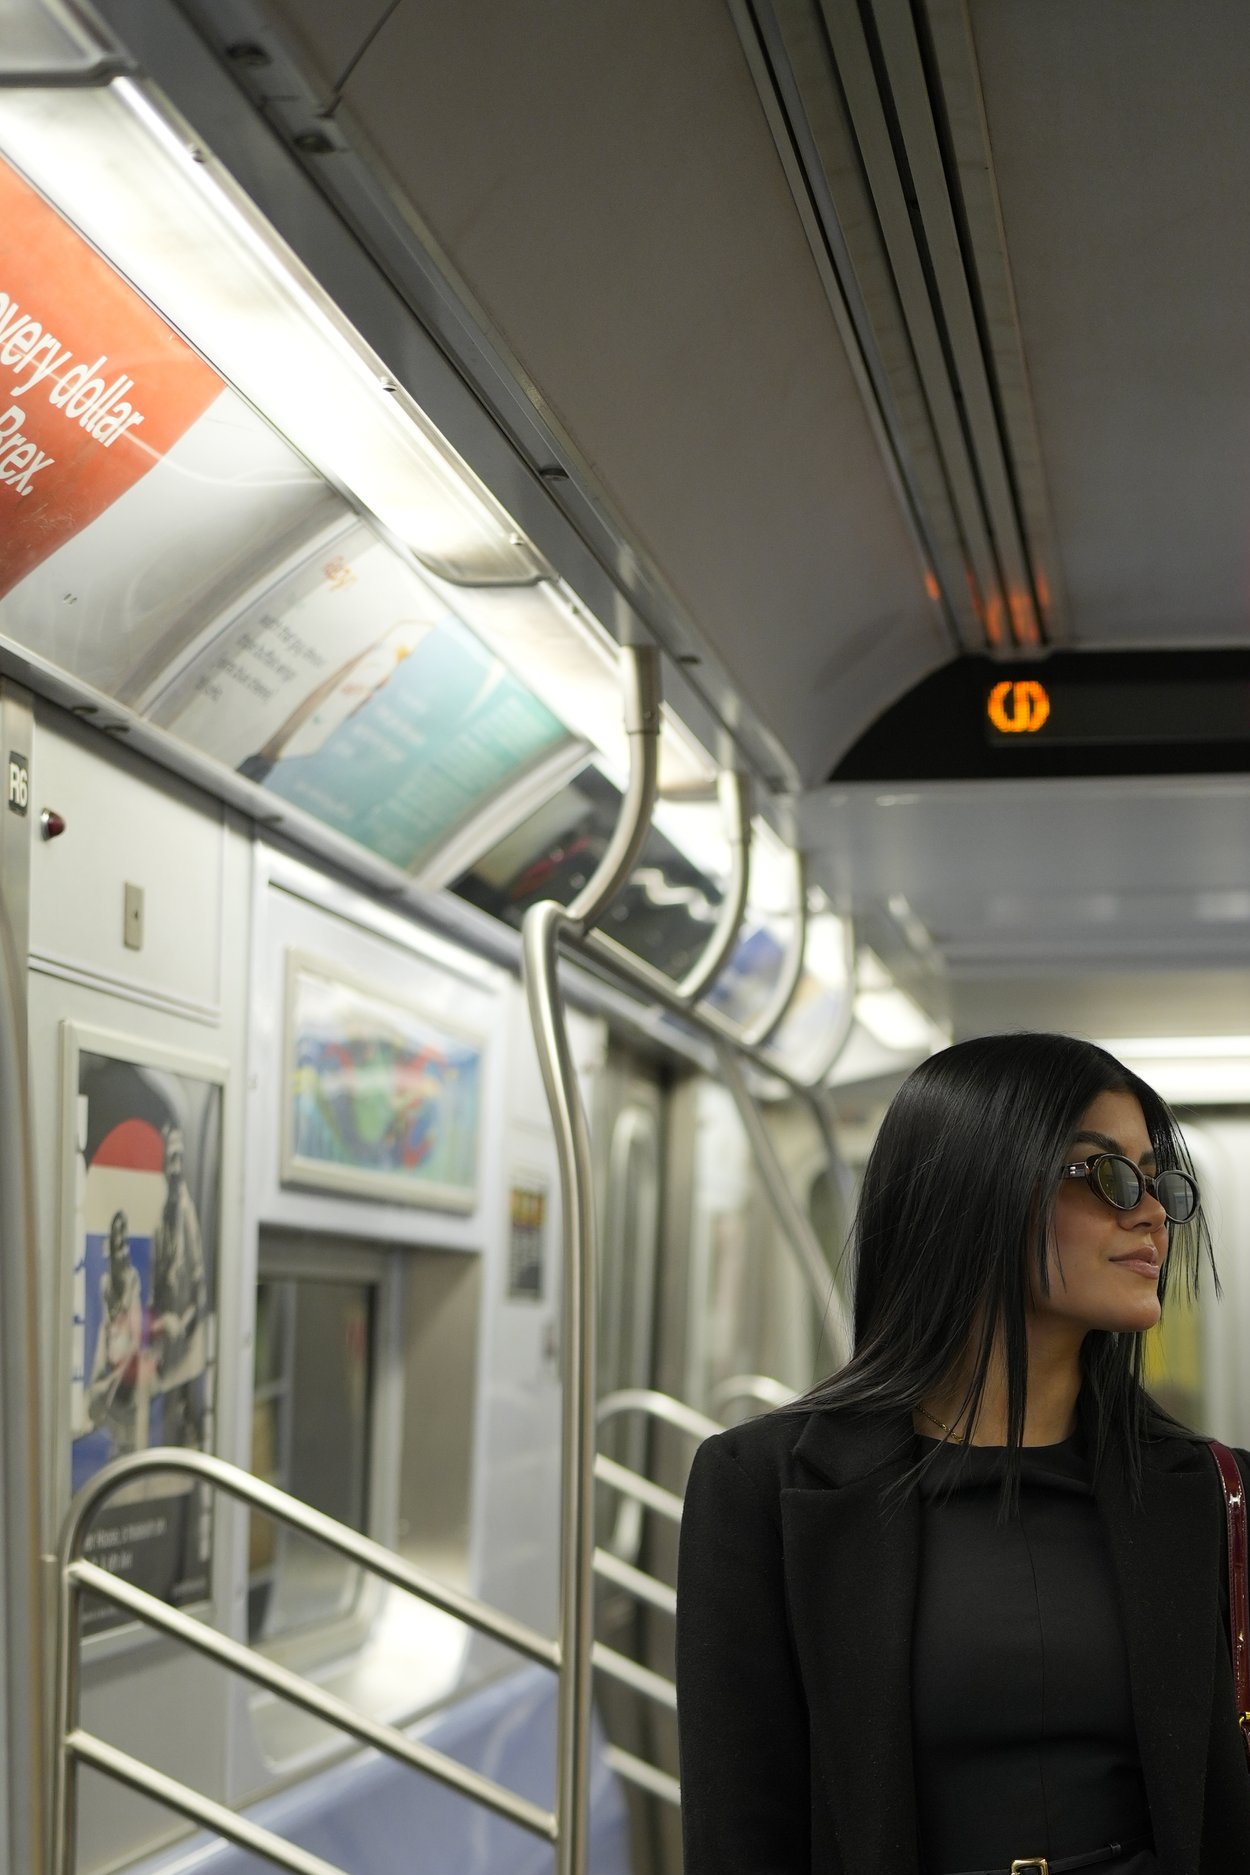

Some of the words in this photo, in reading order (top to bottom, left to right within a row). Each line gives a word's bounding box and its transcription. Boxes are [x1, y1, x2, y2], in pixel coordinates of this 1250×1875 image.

[0, 291, 73, 397] very
[49, 355, 145, 448] dollar
[10, 761, 28, 808] R6
